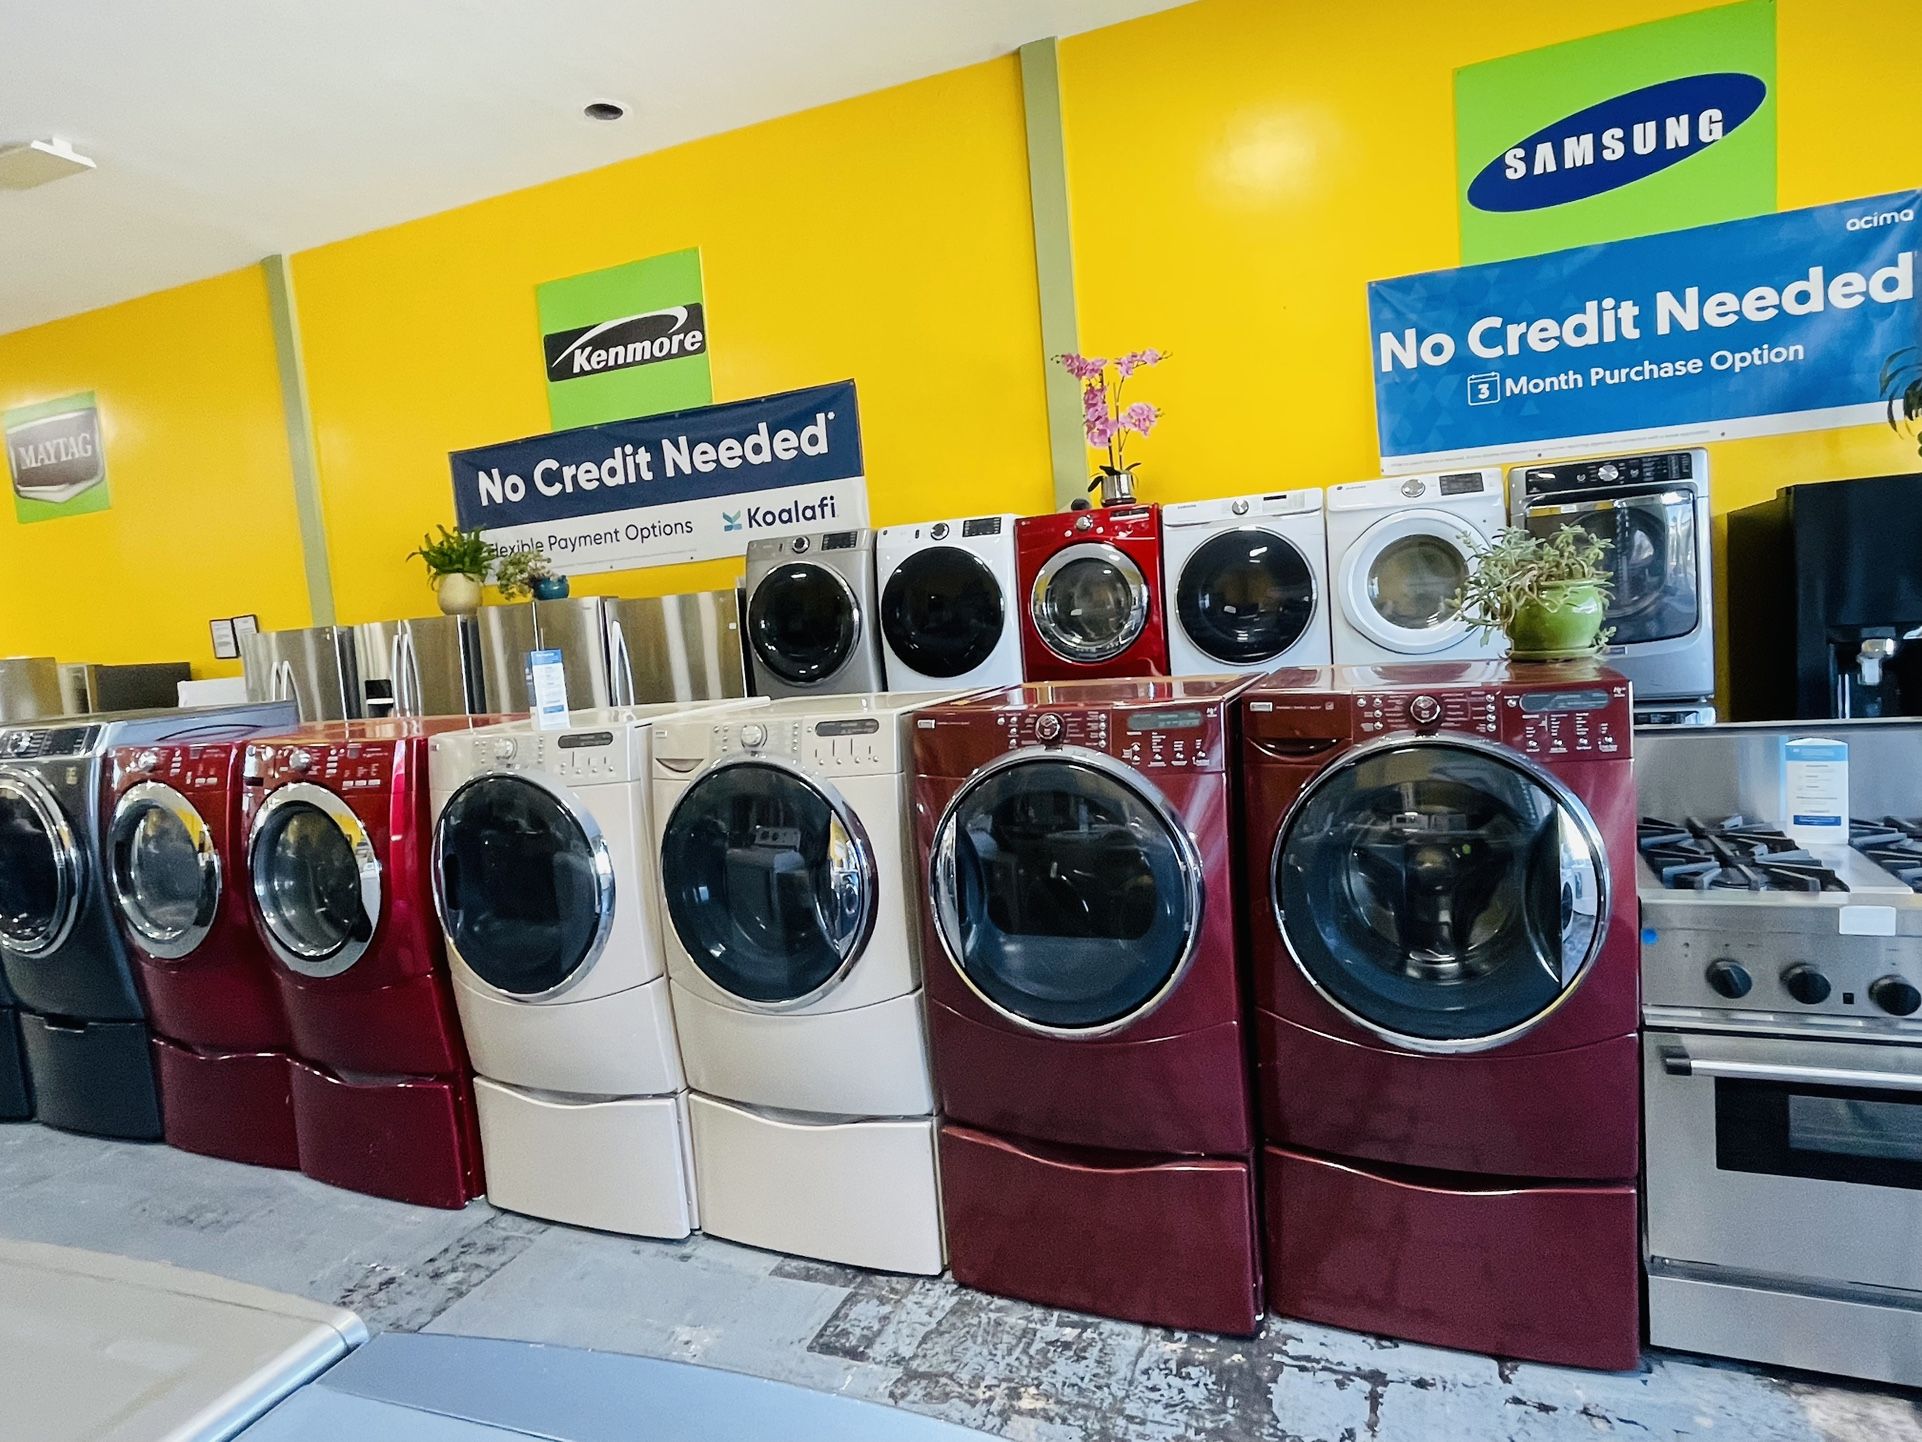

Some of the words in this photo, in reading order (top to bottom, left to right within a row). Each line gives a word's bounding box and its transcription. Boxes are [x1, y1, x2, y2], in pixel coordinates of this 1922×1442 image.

[1504, 108, 1726, 182] SAMSUNG
[1846, 207, 1915, 232] acima
[572, 327, 703, 374] Kenmore
[1380, 328, 1456, 373] No
[1467, 297, 1641, 360] Credit
[1477, 383, 1490, 399] 3
[1505, 370, 1583, 397] Month
[1590, 357, 1703, 388] Purchase
[1710, 342, 1805, 375] Option
[19, 433, 93, 469] MAYTAG
[477, 466, 526, 506] No
[533, 442, 653, 494] Credit
[548, 528, 620, 552] Payment
[625, 519, 693, 543] Options
[747, 495, 836, 529] Koalafi
